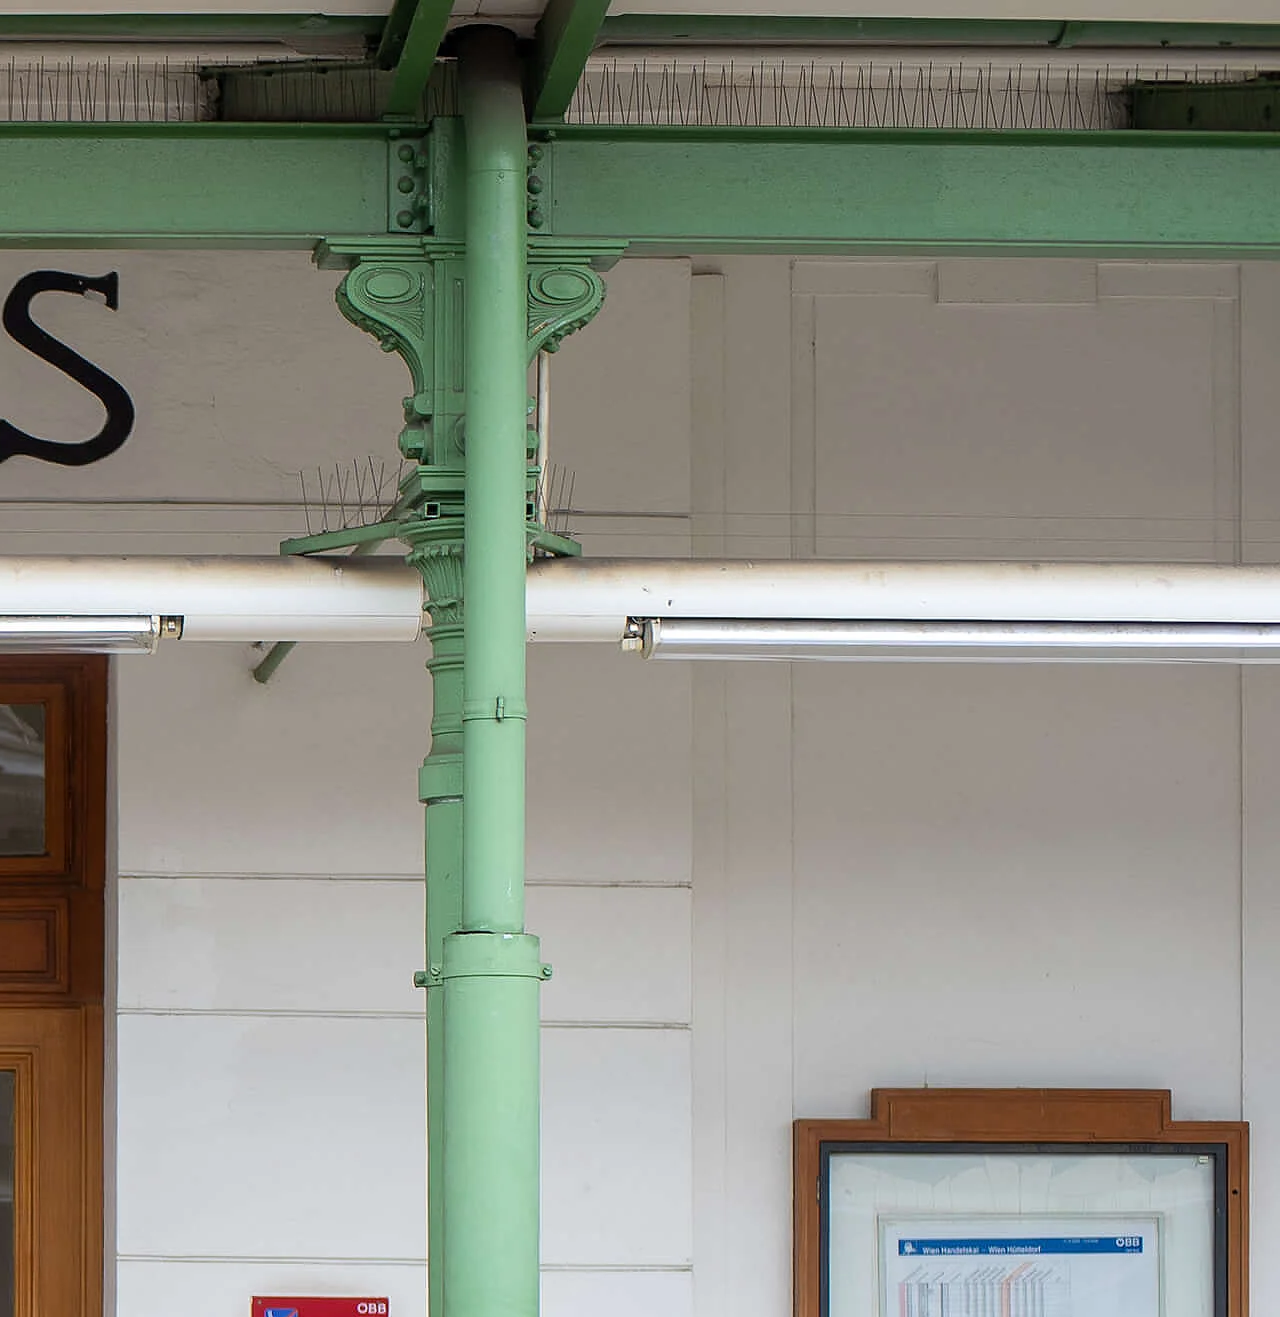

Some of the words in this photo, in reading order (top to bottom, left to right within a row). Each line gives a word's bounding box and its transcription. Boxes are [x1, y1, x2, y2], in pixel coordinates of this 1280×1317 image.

[922, 1246, 940, 1254] Wien
[941, 1246, 980, 1254] Handelskai
[988, 1245, 1006, 1254] Wien
